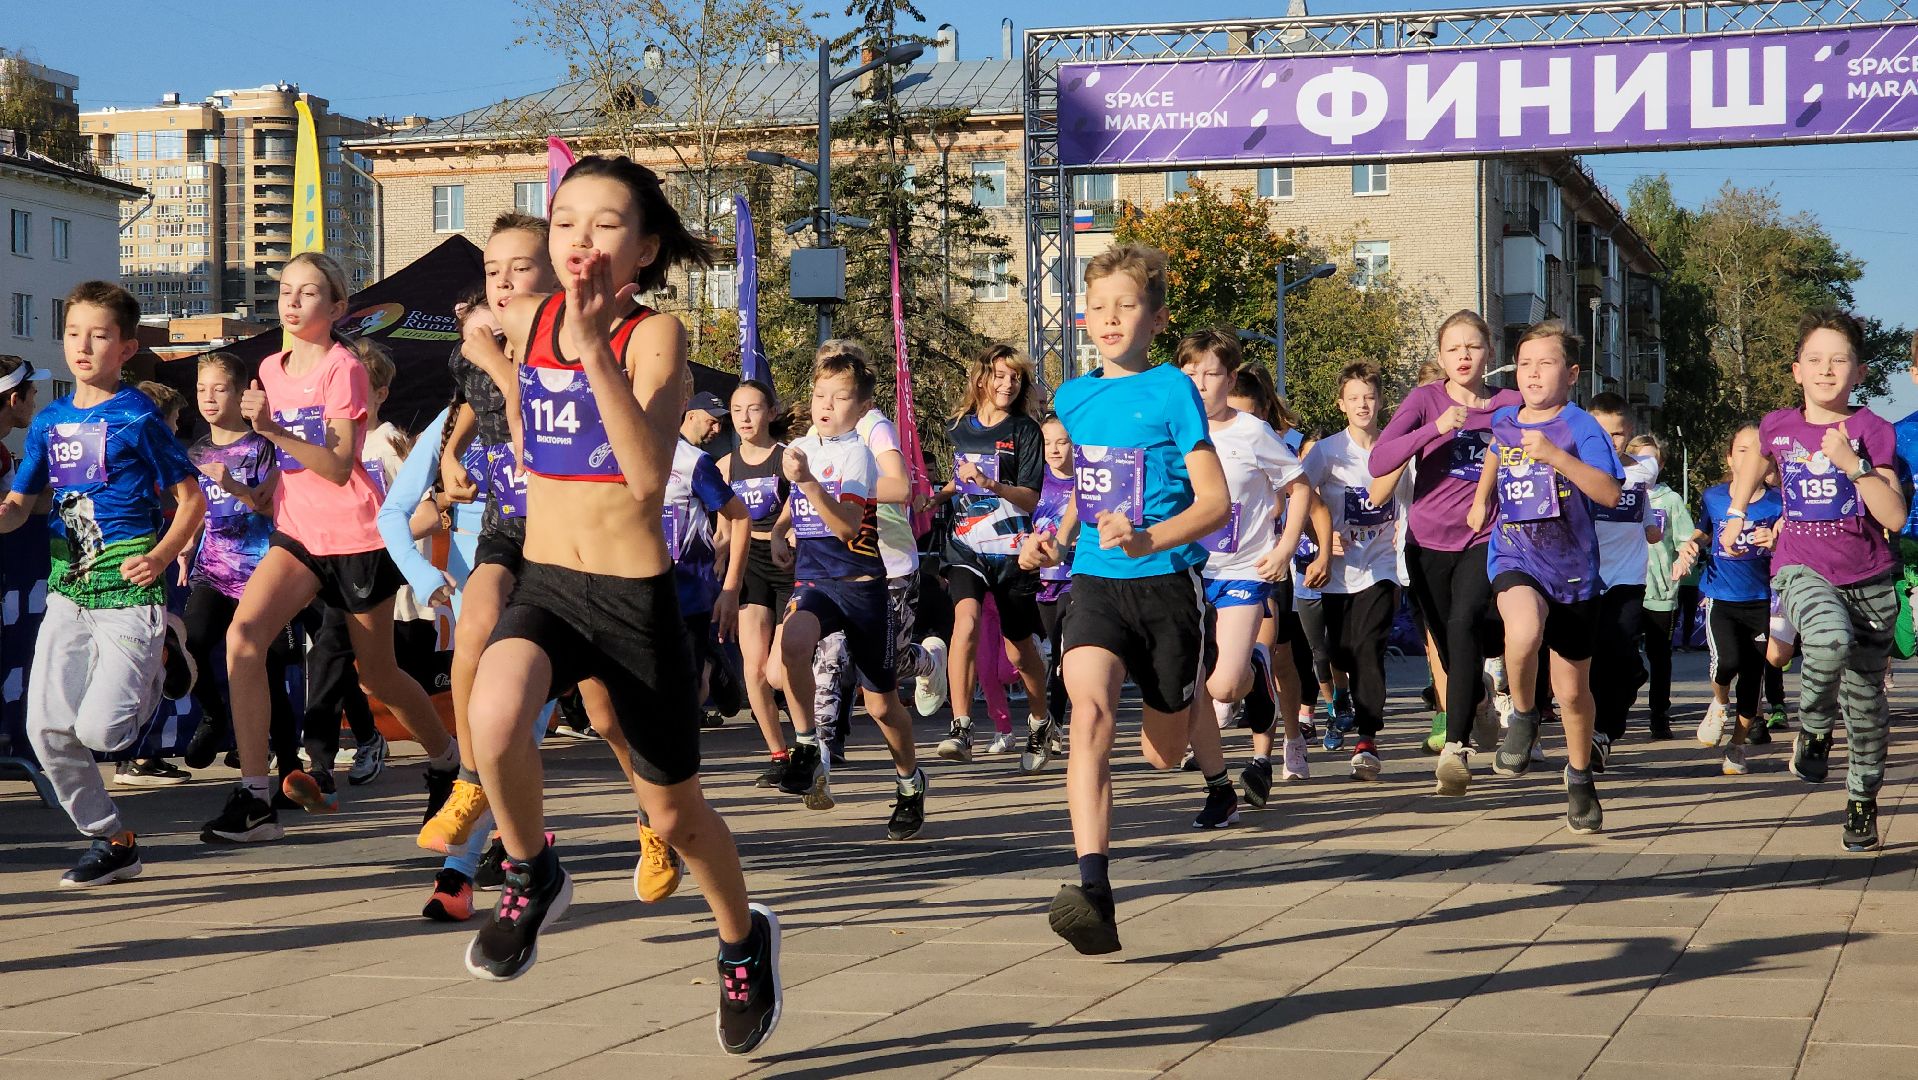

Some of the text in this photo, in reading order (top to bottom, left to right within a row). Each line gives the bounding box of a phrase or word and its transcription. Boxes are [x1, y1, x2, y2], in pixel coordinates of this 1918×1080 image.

[1104, 91, 1174, 109] SPACE
[1296, 45, 1787, 145] ФИНИШ
[1848, 80, 1918, 100] MARA
[1104, 110, 1228, 131] MARATHON
[531, 398, 580, 433] 114
[536, 434, 572, 445] ВИКТОРИЯ
[52, 441, 83, 462] 139
[1075, 466, 1112, 493] 153
[1798, 478, 1838, 498] 135
[741, 490, 764, 505] 112
[1504, 480, 1535, 500] 132
